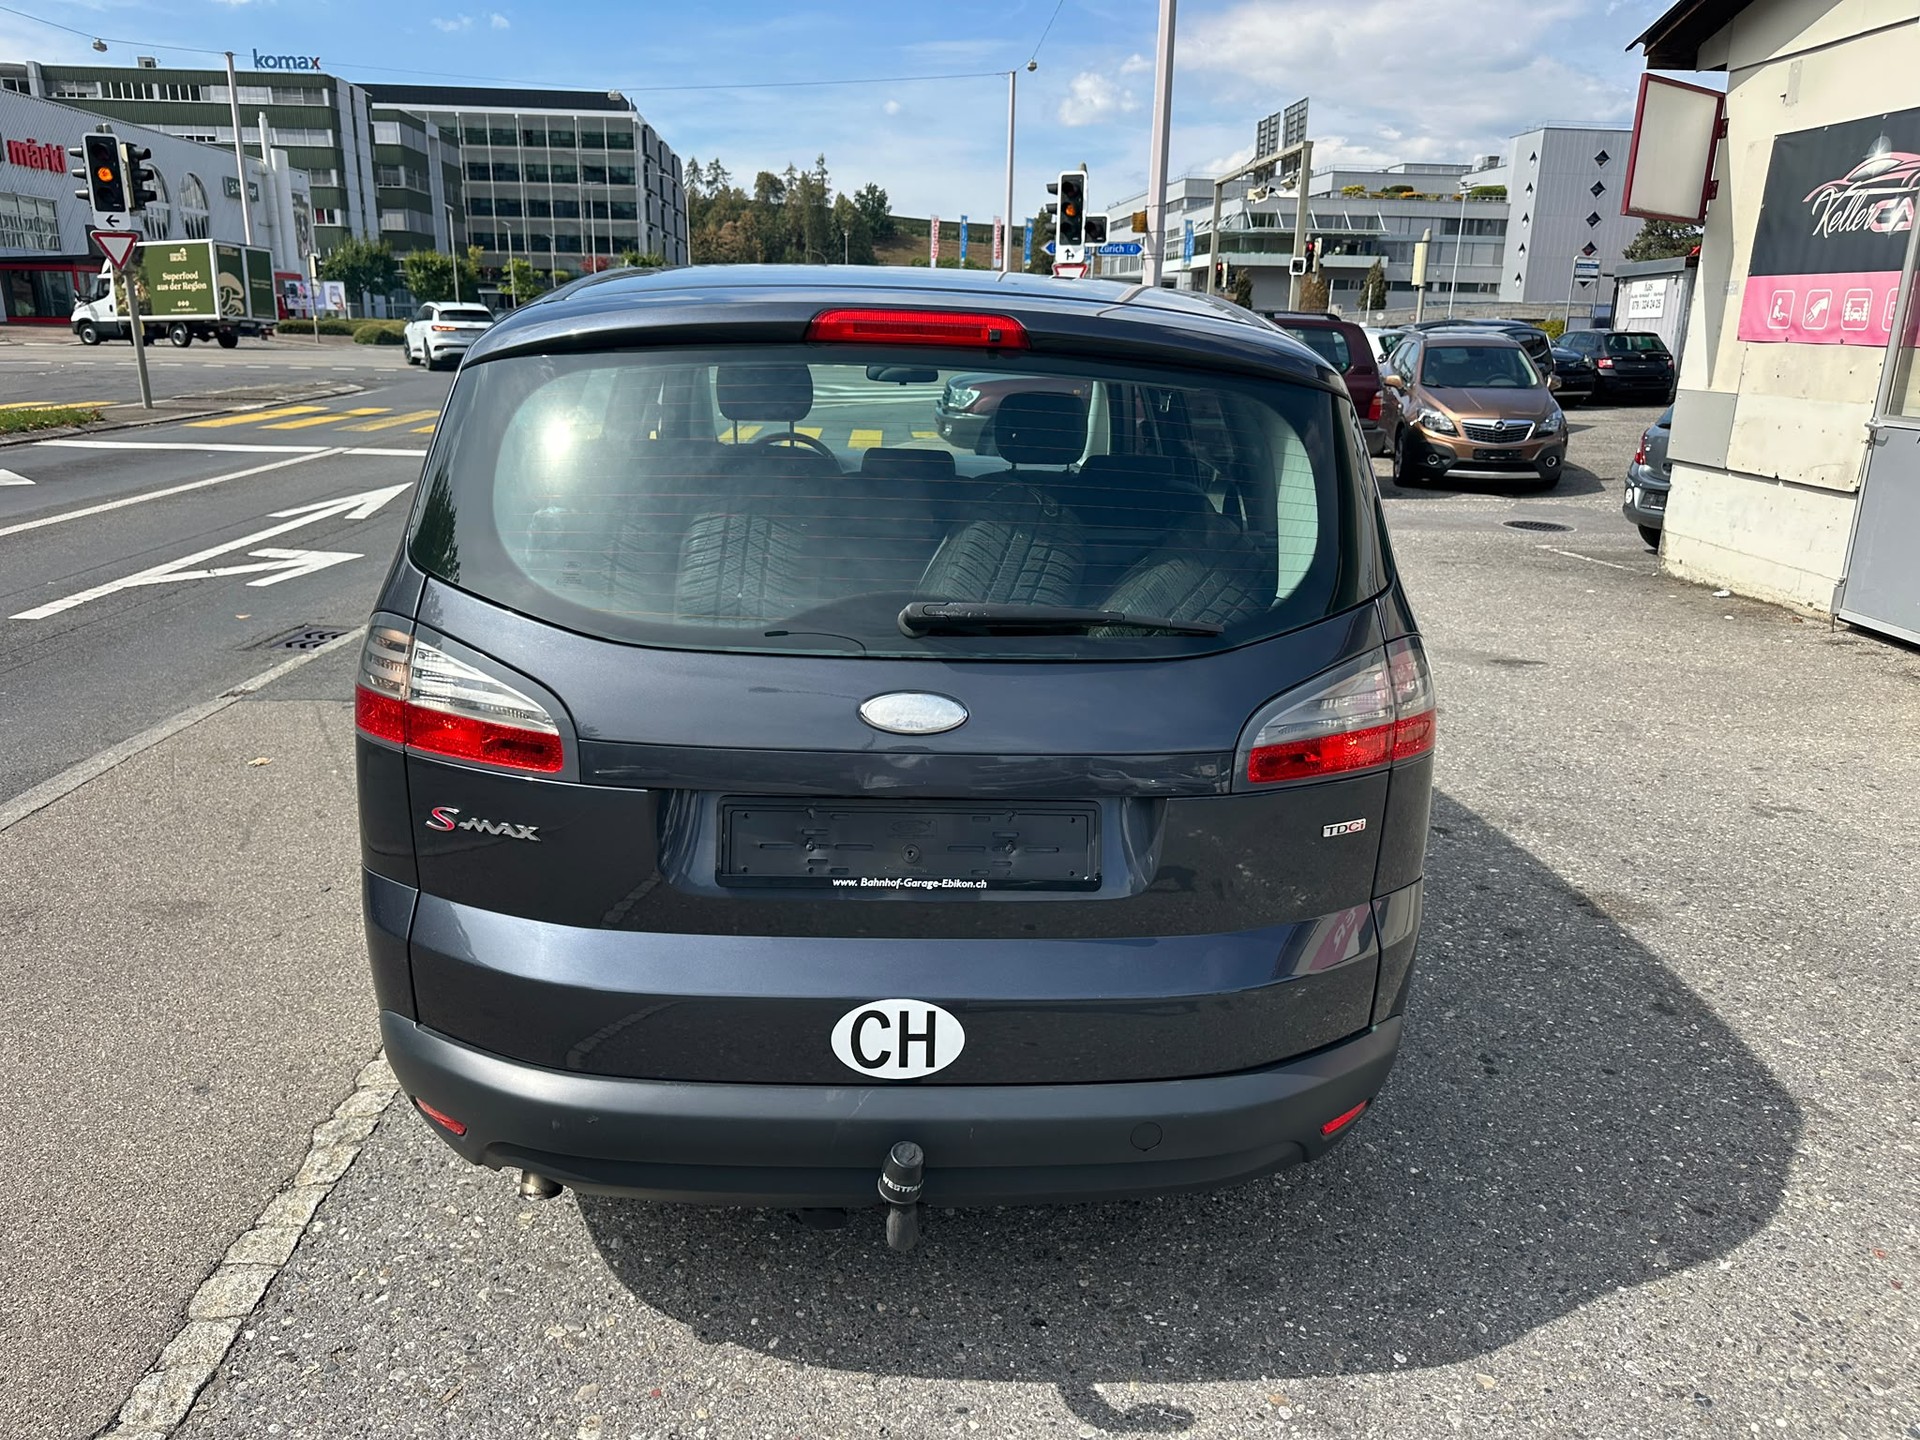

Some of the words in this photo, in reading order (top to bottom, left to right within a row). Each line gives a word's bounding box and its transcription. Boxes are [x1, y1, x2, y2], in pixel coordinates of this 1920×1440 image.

[252, 48, 321, 70] komax
[7, 138, 67, 174] märki
[162, 270, 199, 283] Superfood
[169, 281, 181, 290] der
[182, 280, 207, 292] Region
[425, 806, 541, 841] S-MAX
[1325, 821, 1365, 836] TDCi
[832, 879, 858, 887] www.
[860, 878, 987, 890] Bahnhof-Garage-Ebikon.ch
[850, 1009, 936, 1069] CH
